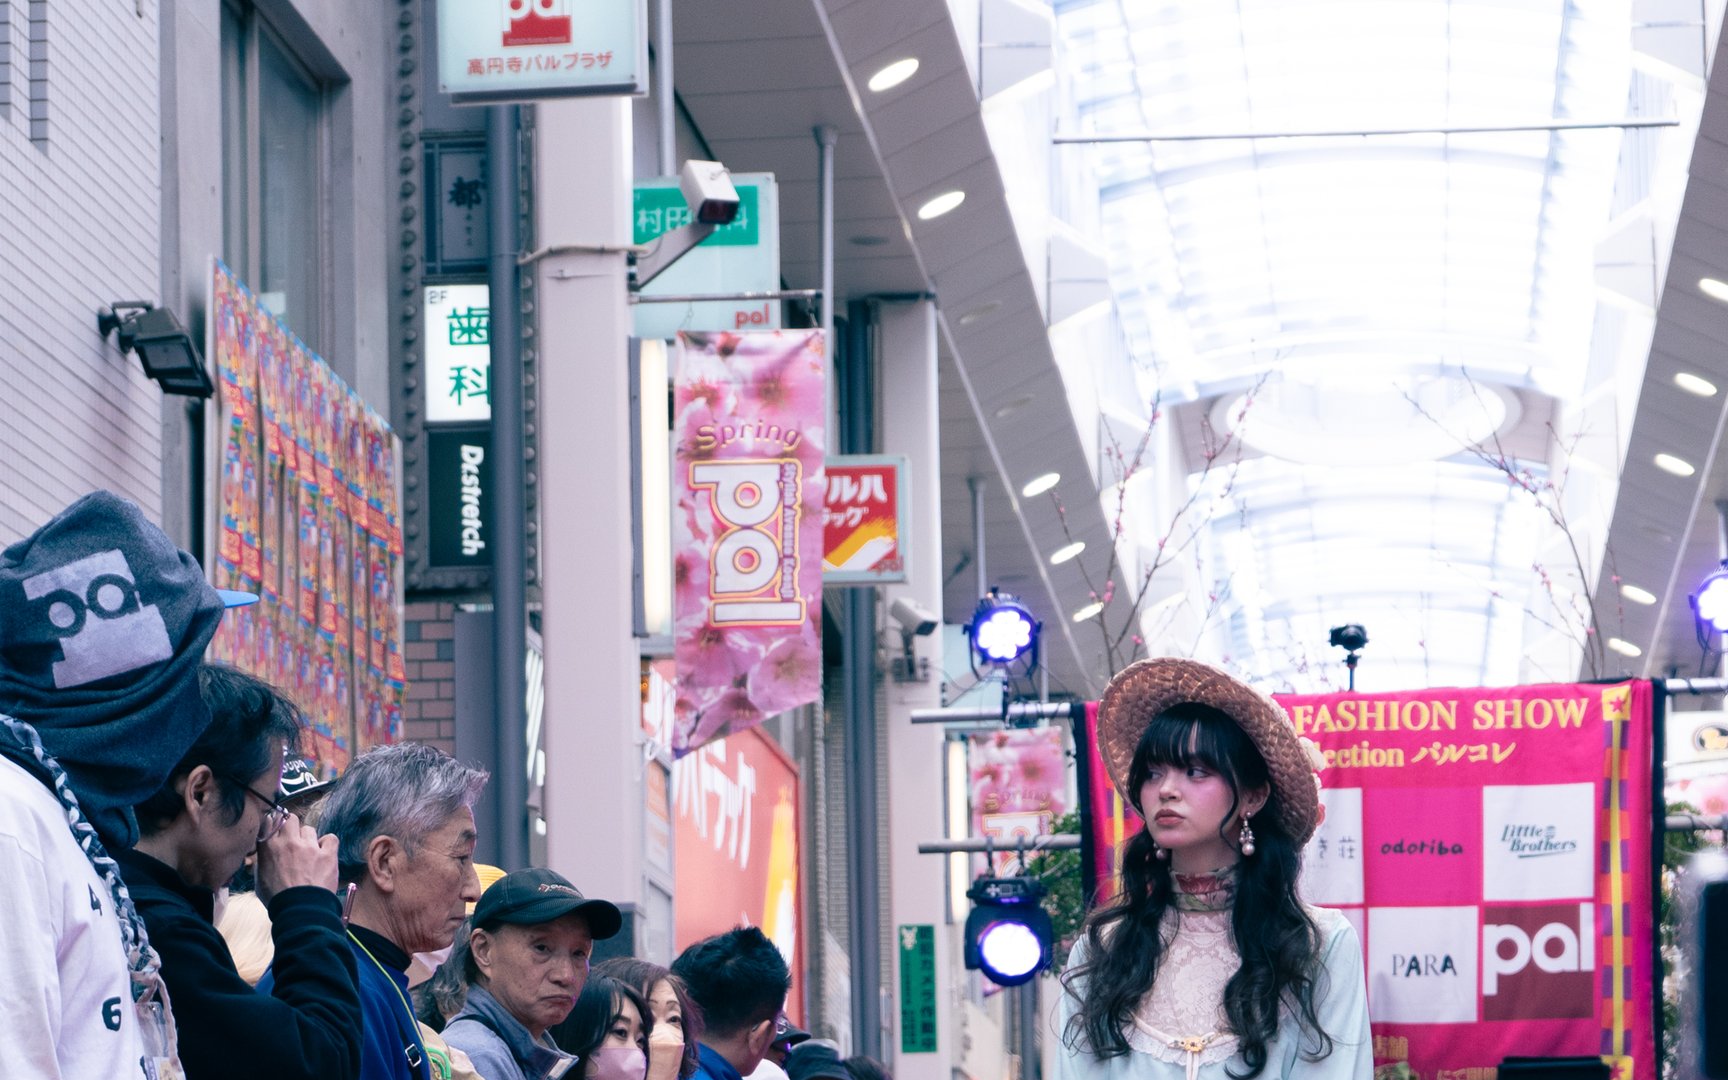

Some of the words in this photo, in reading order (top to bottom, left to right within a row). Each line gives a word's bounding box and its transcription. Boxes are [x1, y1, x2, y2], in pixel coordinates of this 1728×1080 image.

[734, 303, 770, 329] pal
[446, 306, 490, 405] 歯科
[695, 419, 801, 451] Spring
[823, 473, 888, 504] ルハ
[691, 462, 803, 624] pal
[1292, 699, 1458, 735] FASHION
[1472, 697, 1589, 731] SHOW
[1380, 838, 1464, 856] odoriba
[1500, 824, 1543, 842] Little
[1510, 837, 1577, 852] Brothers
[1483, 902, 1595, 996] pal
[1391, 953, 1458, 978] PARA
[102, 996, 122, 1032] 6
